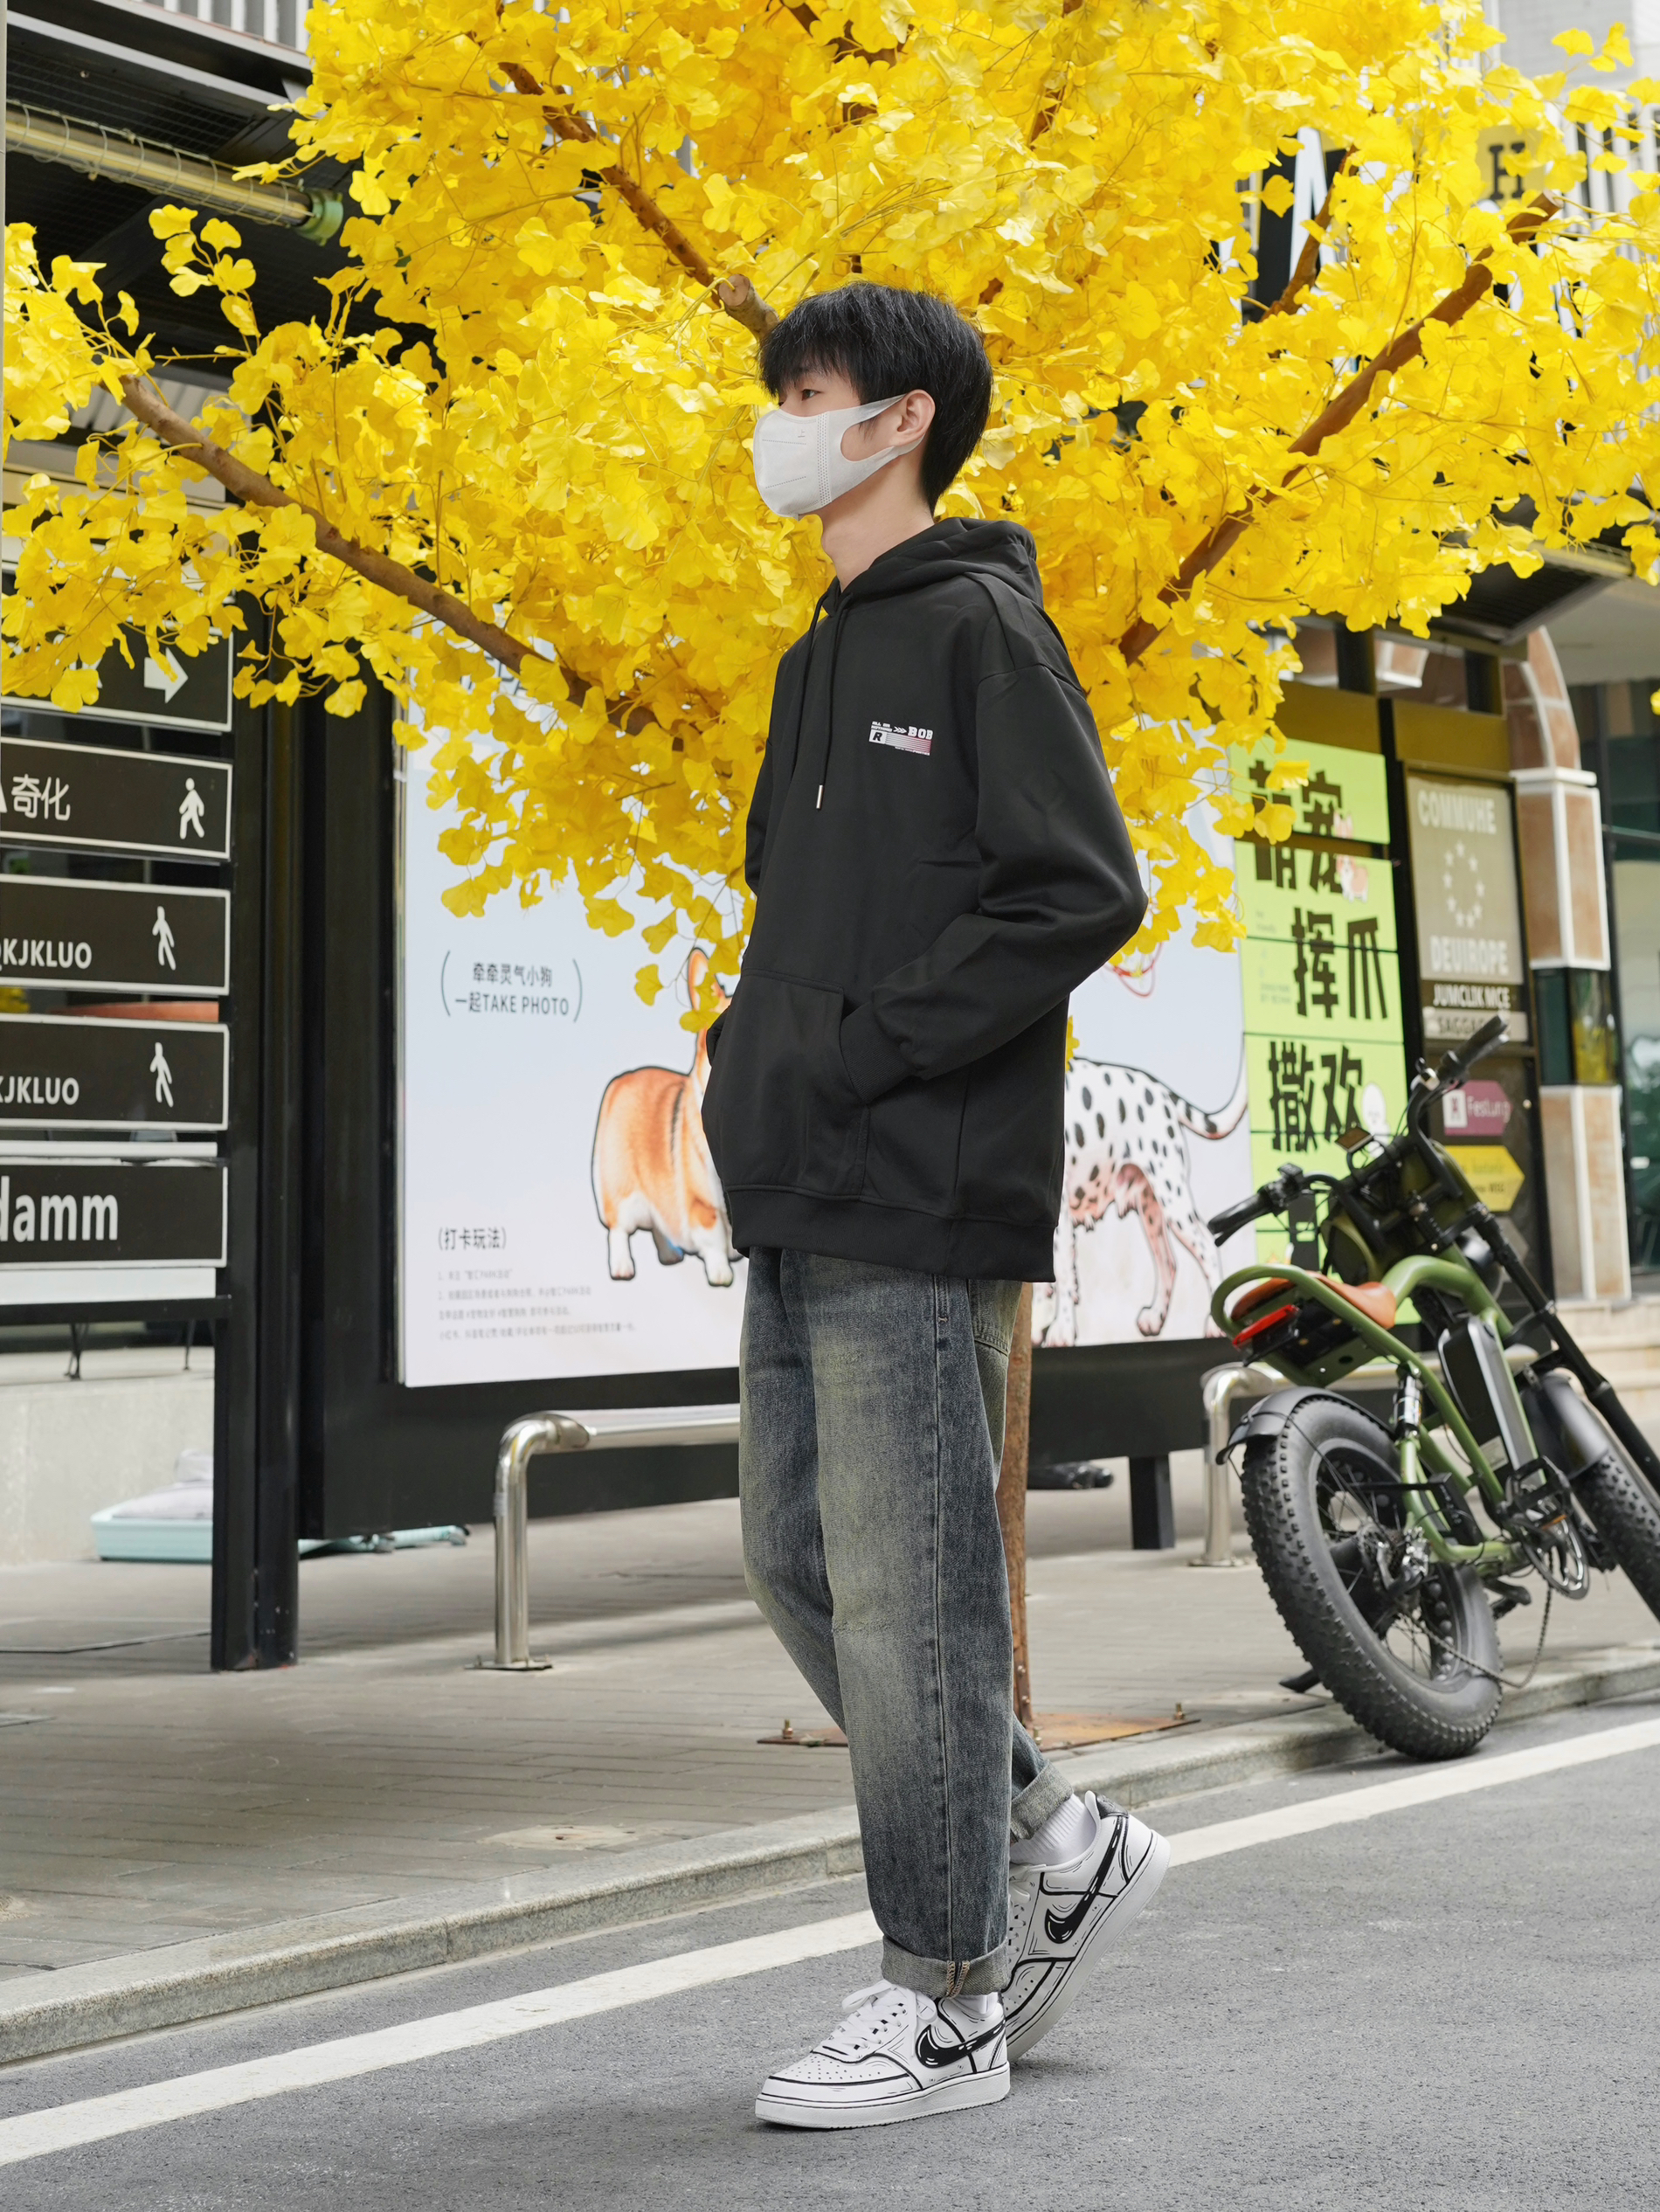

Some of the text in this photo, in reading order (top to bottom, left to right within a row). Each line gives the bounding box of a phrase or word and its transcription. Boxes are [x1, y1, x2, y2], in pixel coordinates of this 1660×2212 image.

[872, 732, 882, 742] R
[908, 726, 933, 740] BOB
[0, 938, 92, 971] KJKLUO
[1290, 907, 1388, 1020] 挥爪
[473, 962, 553, 988] 牵牵灵气小狗
[522, 996, 570, 1016] PHOTO
